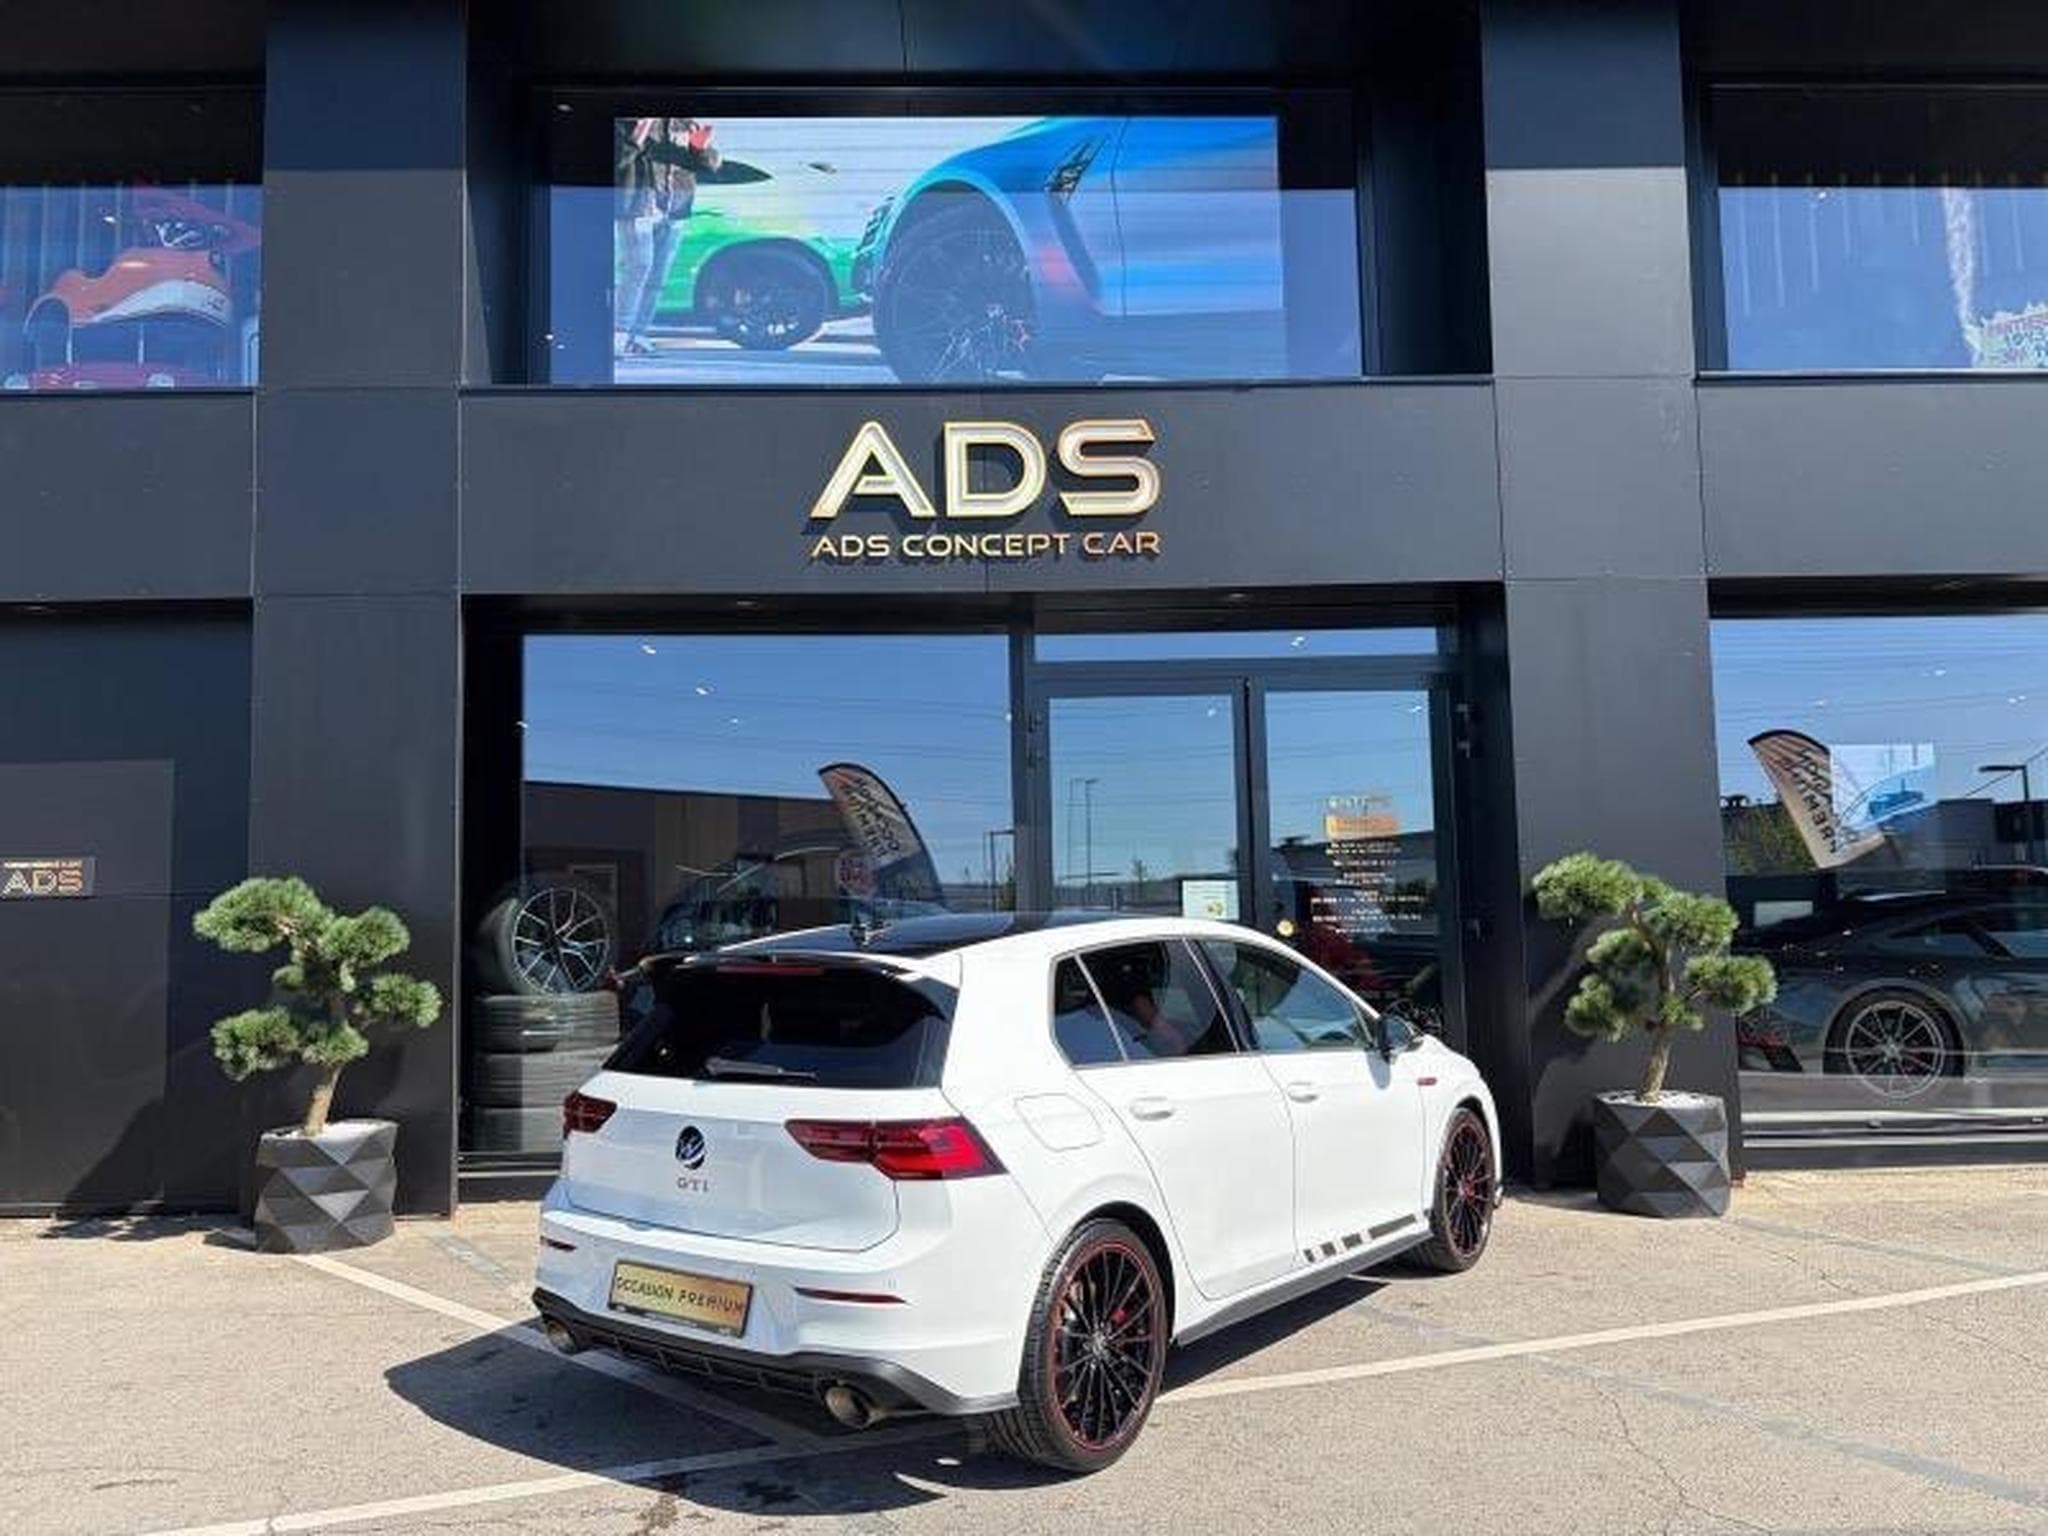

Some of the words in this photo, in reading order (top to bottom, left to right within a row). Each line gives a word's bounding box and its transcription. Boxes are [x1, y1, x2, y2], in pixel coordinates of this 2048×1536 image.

[810, 418, 1160, 518] ADS
[811, 535, 890, 557] ADS
[902, 533, 1071, 557] CONCEPT
[1083, 531, 1161, 555] CAR
[2, 869, 83, 895] ADS
[677, 1177, 709, 1192] GTI
[616, 1275, 674, 1302] OCCASION
[677, 1289, 744, 1315] PREMIUM
